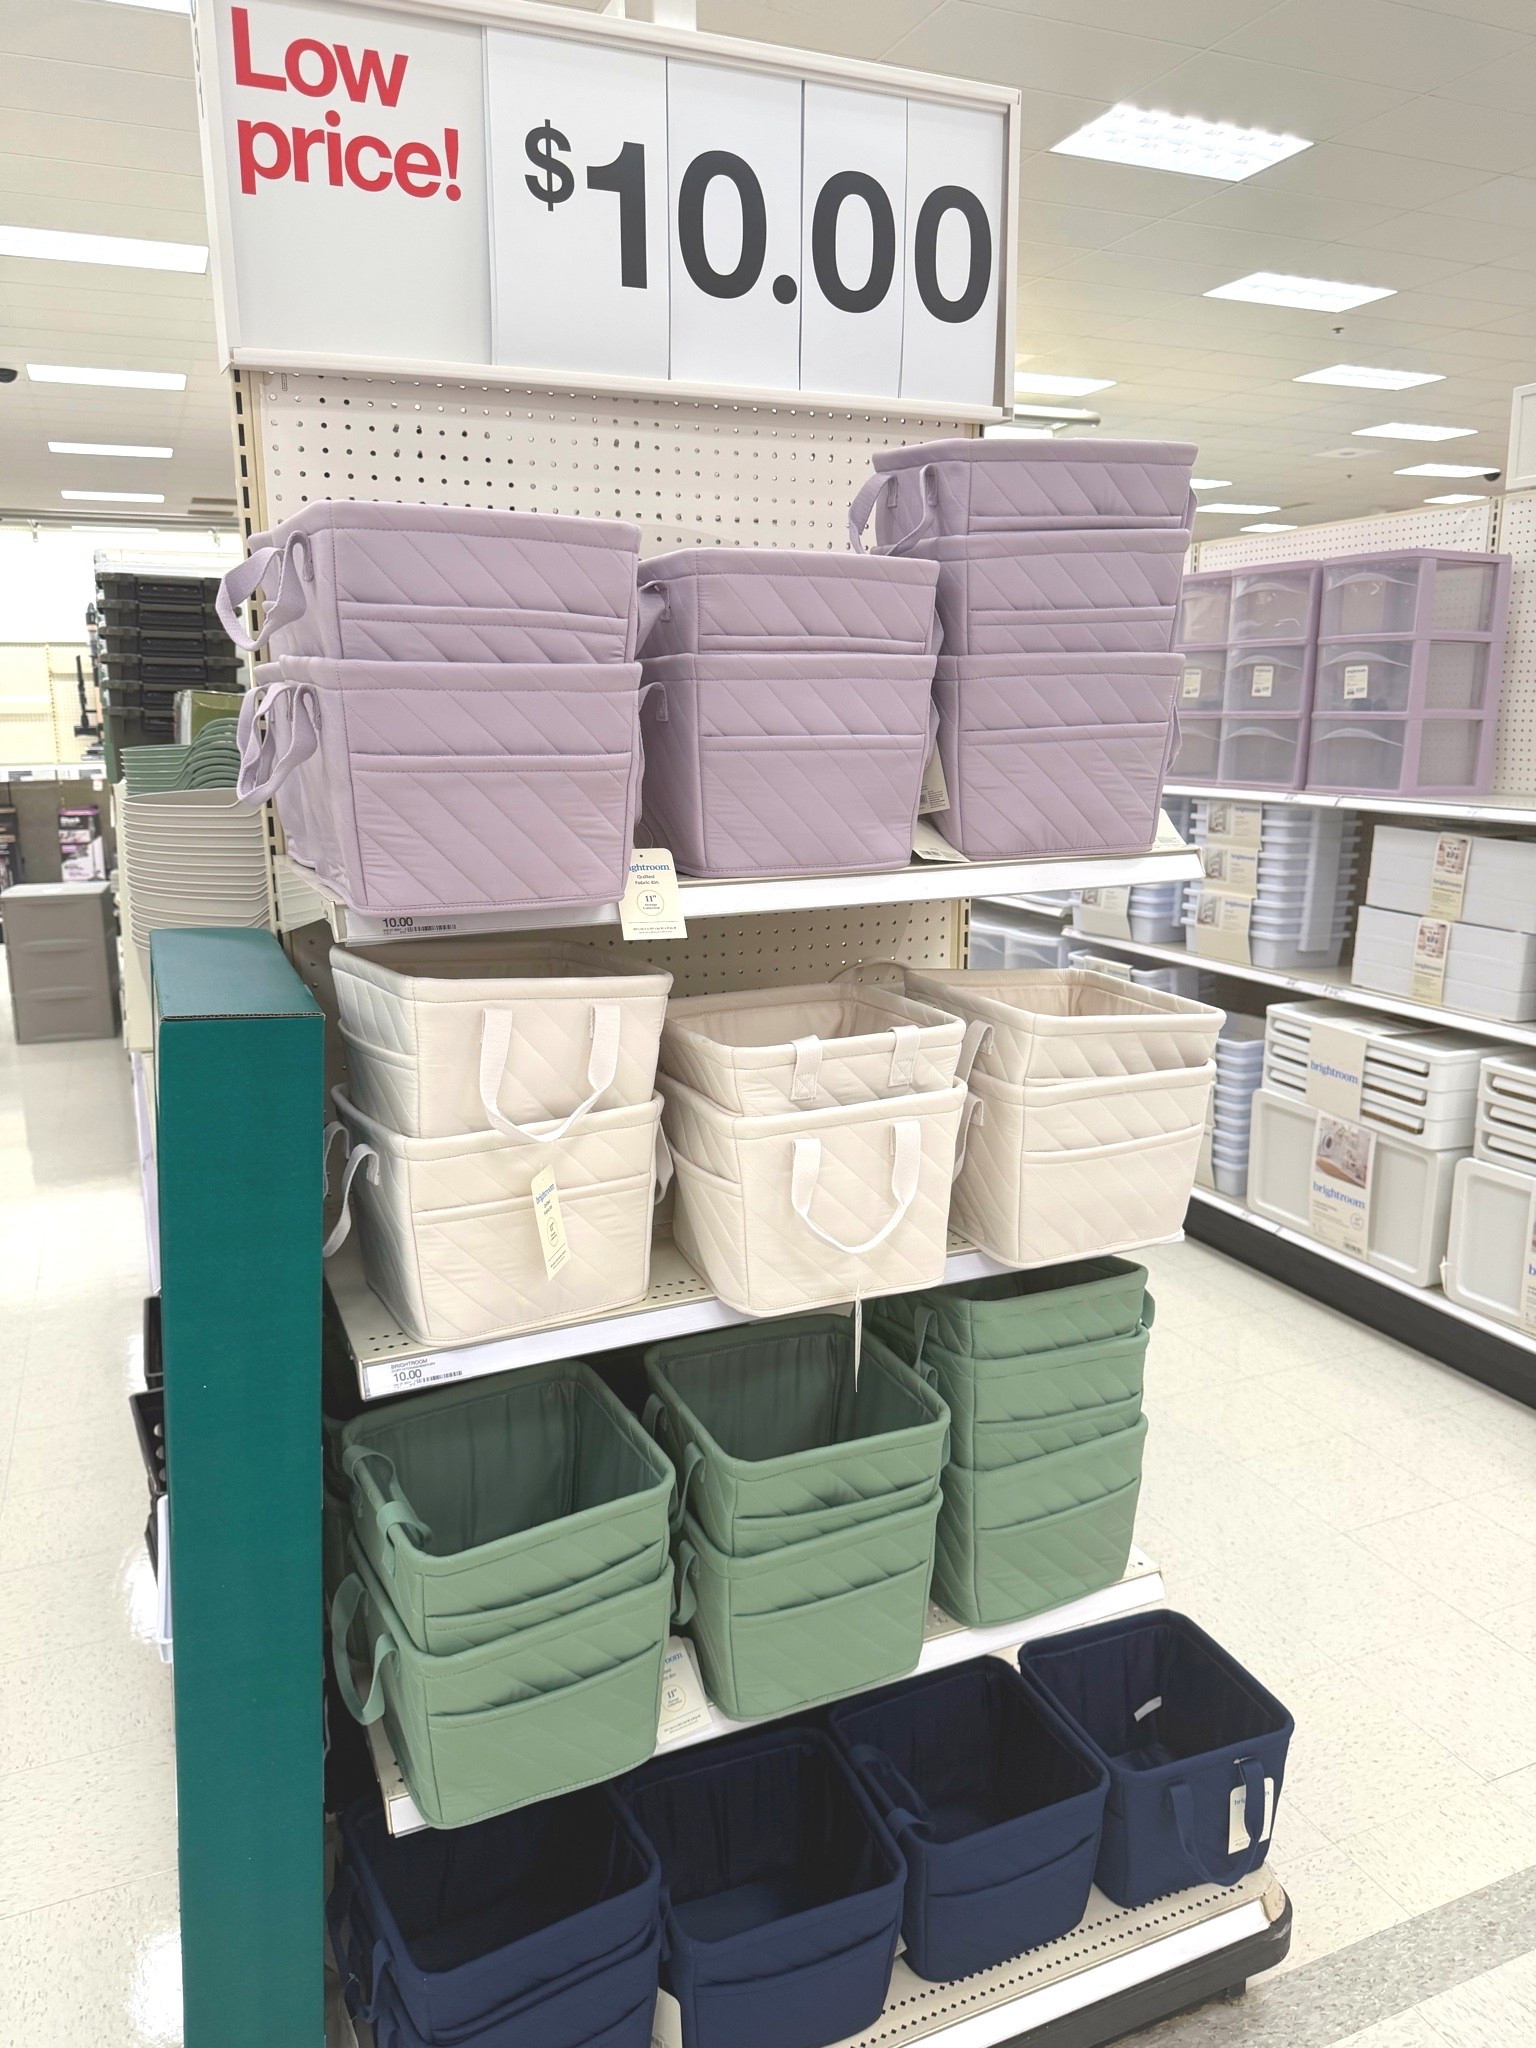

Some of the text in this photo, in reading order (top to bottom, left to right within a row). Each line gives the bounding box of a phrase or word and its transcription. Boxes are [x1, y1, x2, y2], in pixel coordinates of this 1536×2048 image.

[231, 7, 409, 108] Low
[237, 110, 463, 202] price!
[524, 118, 992, 324] $10.00
[383, 917, 413, 928] 10.00
[1311, 1060, 1358, 1084] brightroom
[1313, 1181, 1366, 1209] brightroom
[391, 1358, 428, 1369] BRIGHTROOM
[393, 1369, 422, 1382] 10.00
